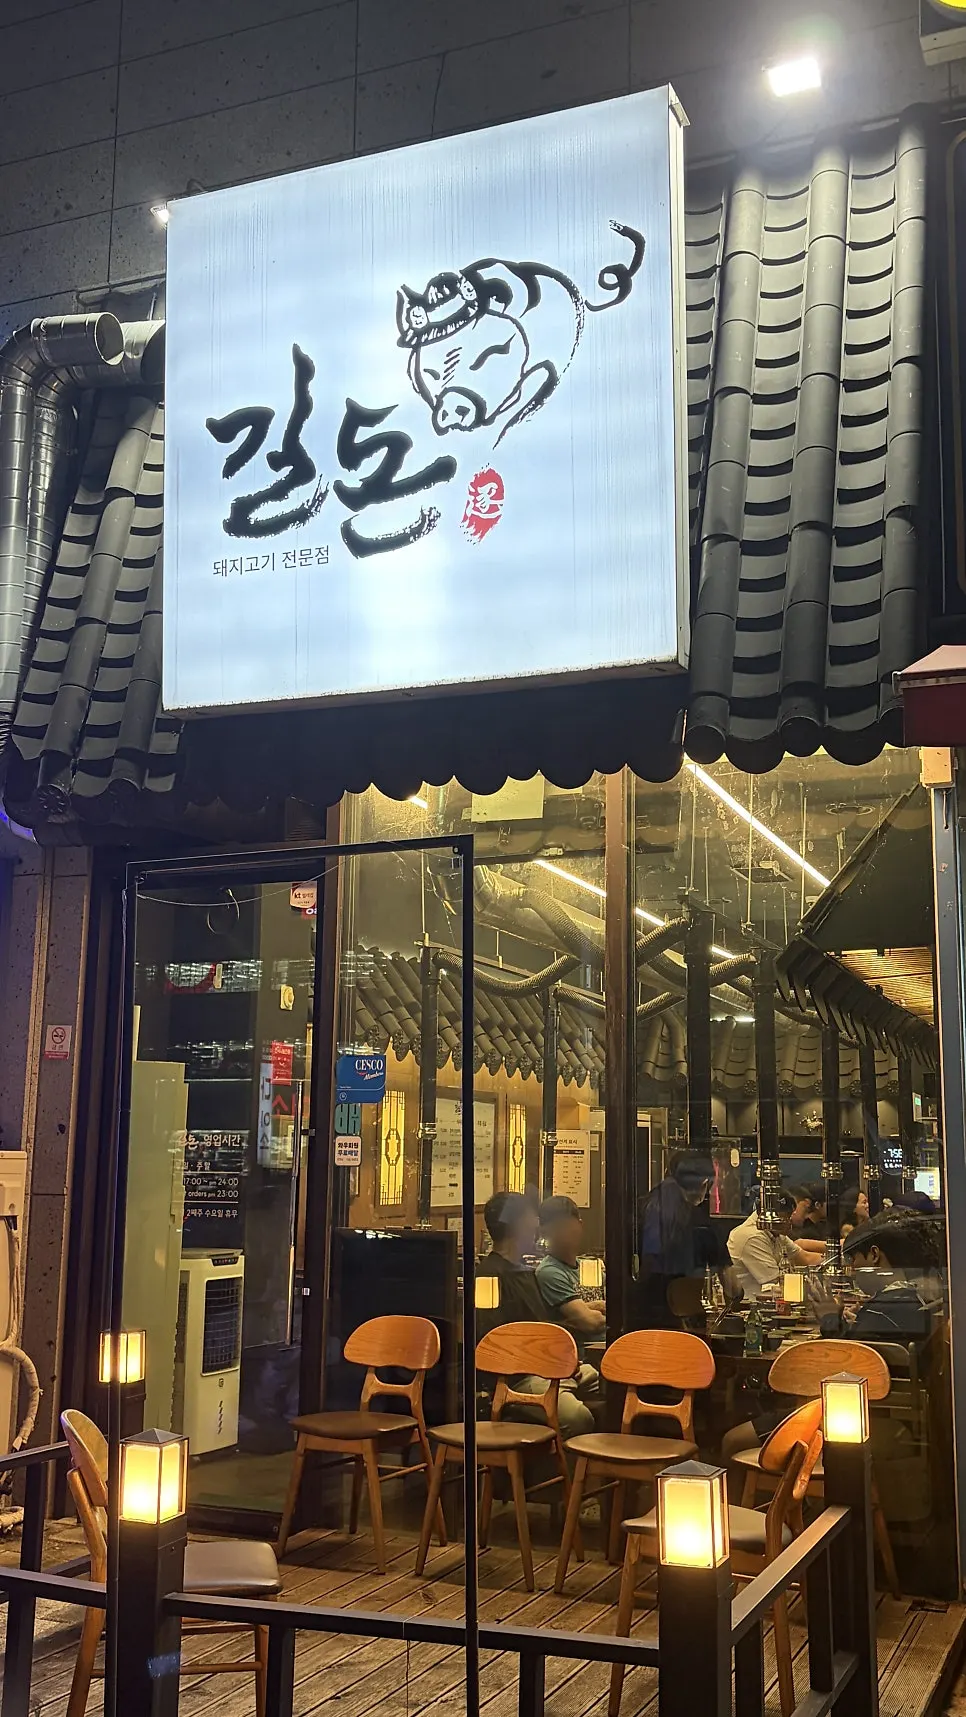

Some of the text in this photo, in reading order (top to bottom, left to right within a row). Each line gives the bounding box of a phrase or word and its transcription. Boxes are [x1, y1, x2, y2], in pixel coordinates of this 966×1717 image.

[206, 343, 457, 559] 길돈
[213, 545, 330, 577] 돼지고기 전문점
[355, 1059, 384, 1071] CESCO
[203, 1134, 241, 1147] 영업시간
[217, 1177, 239, 1186] 24:00
[188, 1190, 207, 1198] orders
[216, 1190, 239, 1198] 23:00
